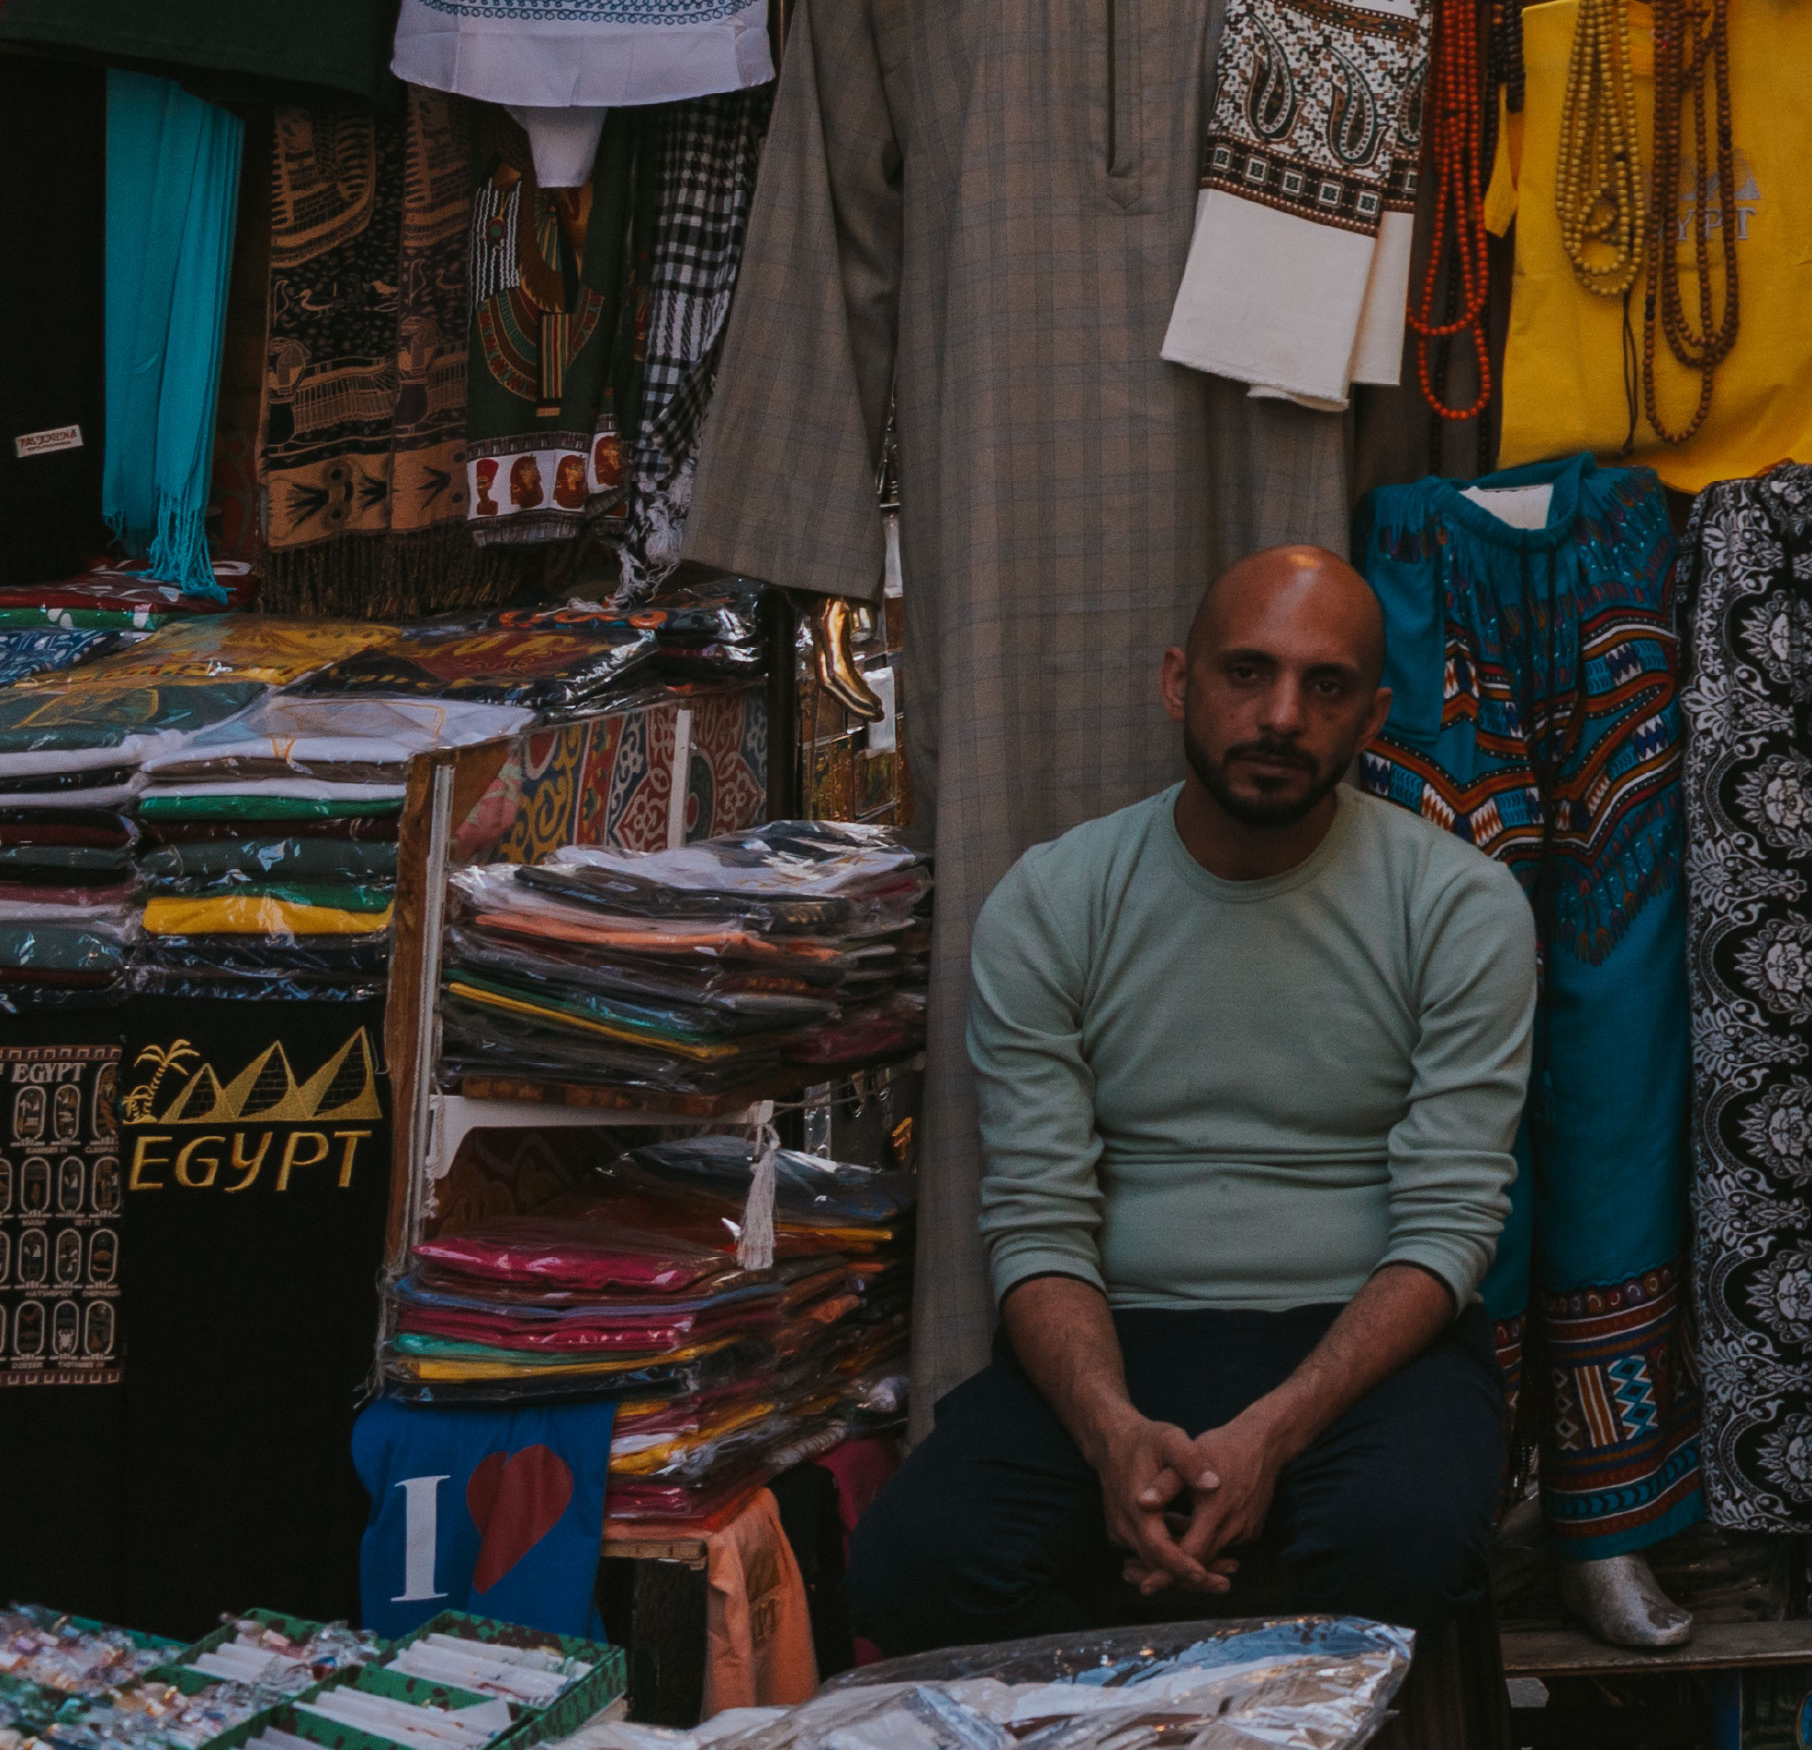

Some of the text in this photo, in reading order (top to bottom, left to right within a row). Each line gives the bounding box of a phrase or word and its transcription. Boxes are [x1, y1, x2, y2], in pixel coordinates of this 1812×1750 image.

[10, 1062, 87, 1084] EGYPT
[129, 1129, 375, 1194] EGYPT
[391, 1474, 450, 1605] I
